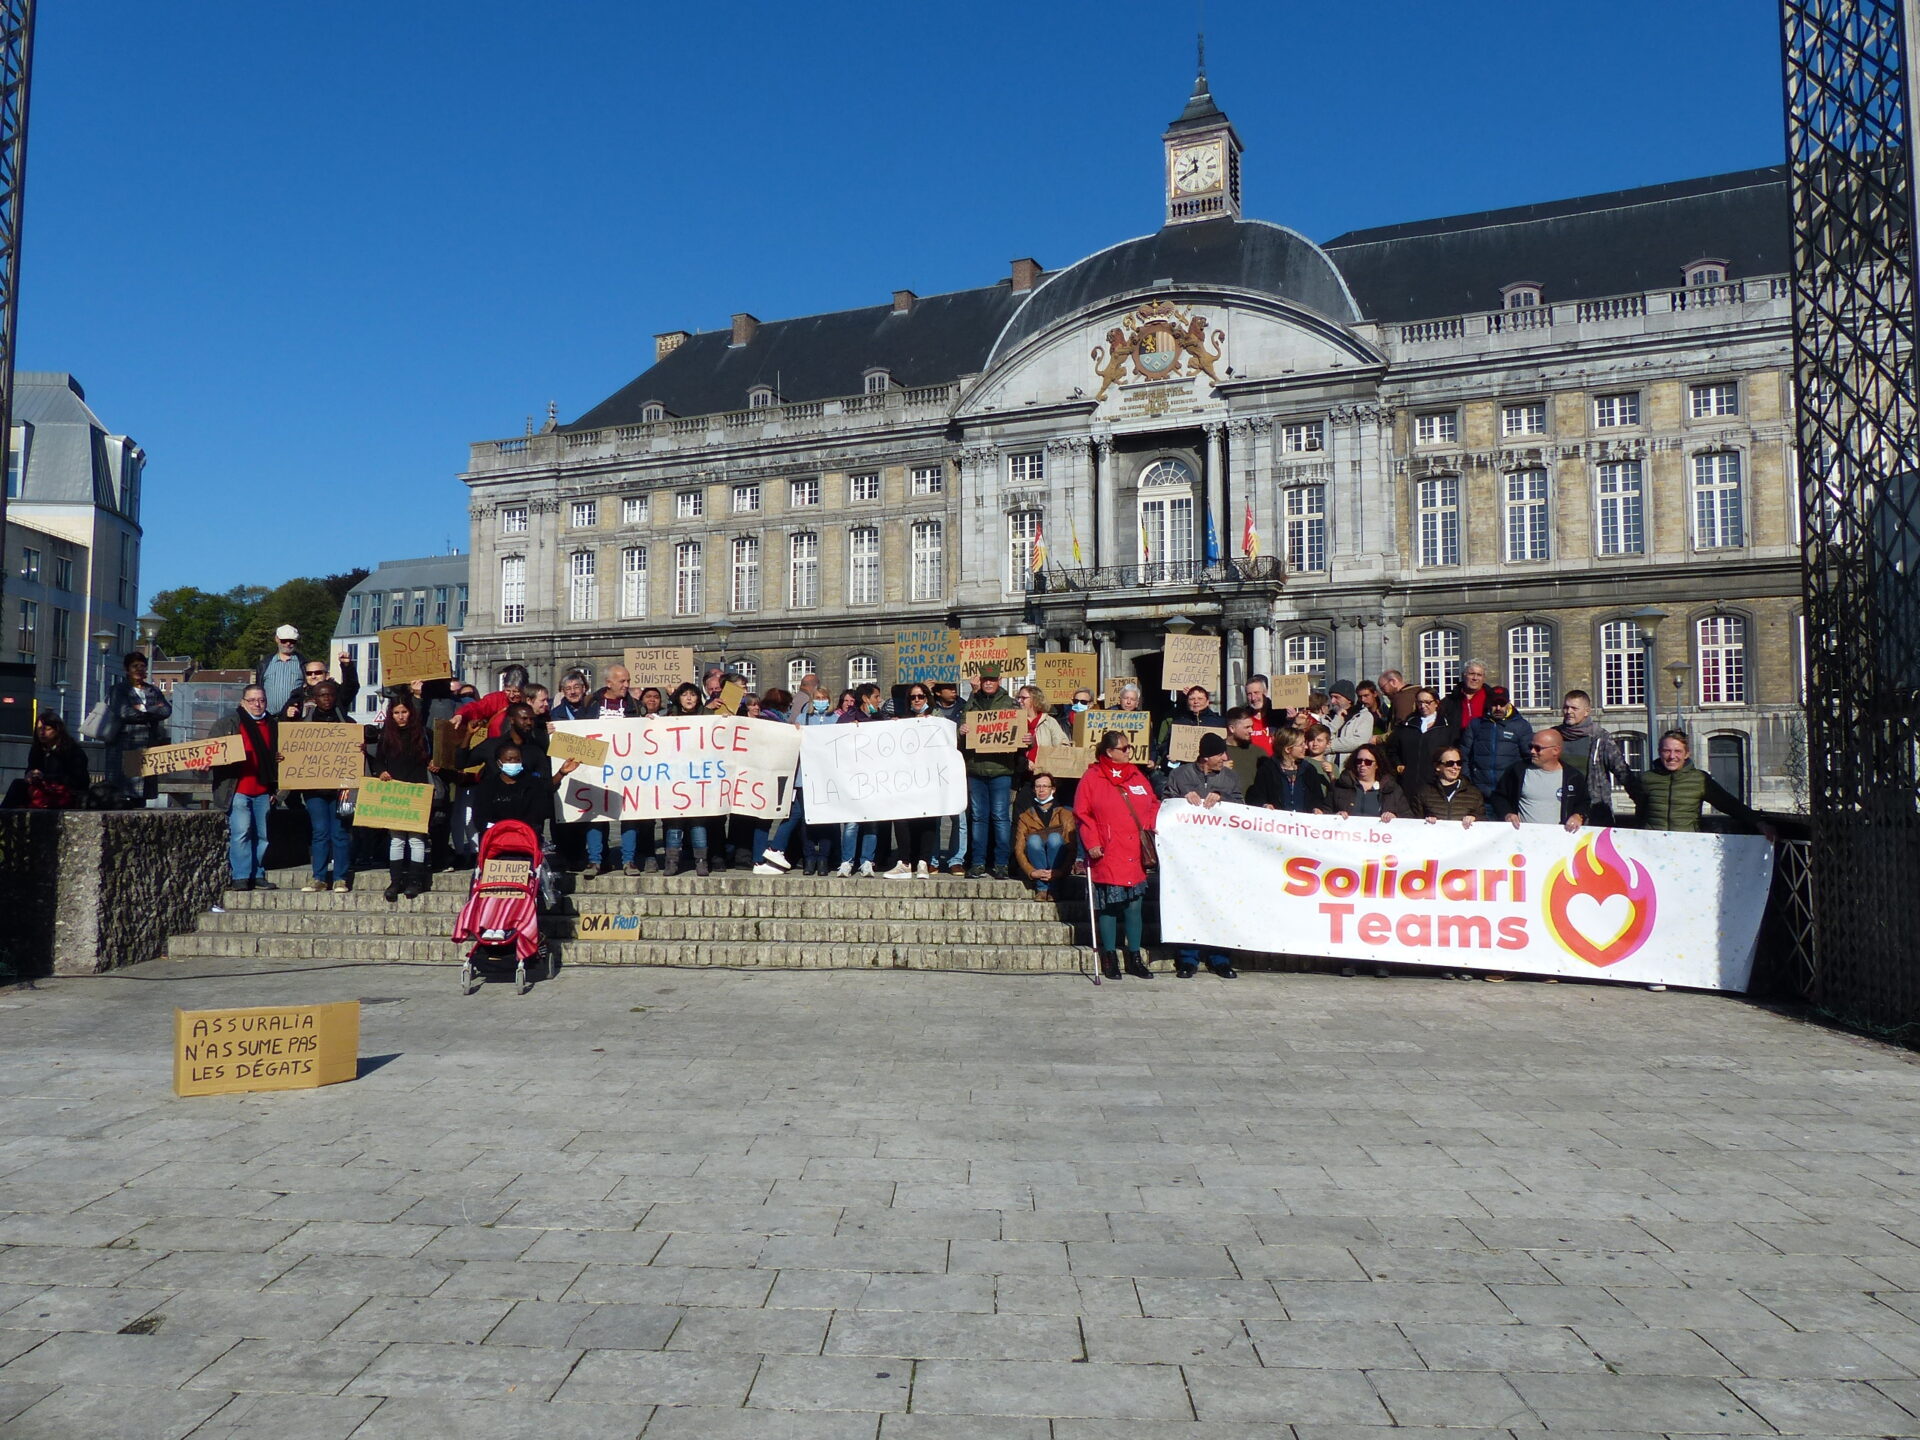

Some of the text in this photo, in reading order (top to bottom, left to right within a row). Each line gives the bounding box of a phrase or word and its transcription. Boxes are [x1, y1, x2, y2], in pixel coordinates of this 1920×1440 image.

[392, 629, 436, 653] SOS
[899, 643, 948, 654] DES MOIS
[960, 639, 994, 649] XPERTS
[635, 649, 680, 660] JUSTICE
[898, 654, 955, 665] POUR S'EN
[635, 662, 680, 671] POUR LES
[961, 657, 1026, 677] ARNEURS
[1044, 659, 1073, 668] NOTRE
[1045, 679, 1081, 688] EST EN
[977, 712, 998, 723] PAYS
[1111, 712, 1148, 721] ENFANTS
[290, 725, 347, 739] INONDÉS
[976, 722, 1009, 734] PAUVRE
[1087, 721, 1144, 729] SONT MALADES
[282, 738, 361, 754] ABANDONNÉS
[586, 726, 750, 757] USTICE
[825, 724, 949, 769] TROOZ
[141, 747, 200, 767] ASSUREURS
[184, 756, 212, 768] VOUS
[302, 754, 357, 768] MAIS PAS
[603, 760, 726, 783] POUR LES
[811, 778, 840, 805] LA
[1176, 811, 1393, 844] www.SolidariTeams.be
[489, 861, 528, 873] DI RUPO
[1282, 854, 1526, 903] Solidari
[582, 914, 639, 931] ON A FROID
[1318, 902, 1529, 950] Teams
[193, 1013, 313, 1038] ASSURALIA
[185, 1035, 318, 1061] N'ASSUME PAS
[192, 1058, 314, 1081] LES DÉGATS
